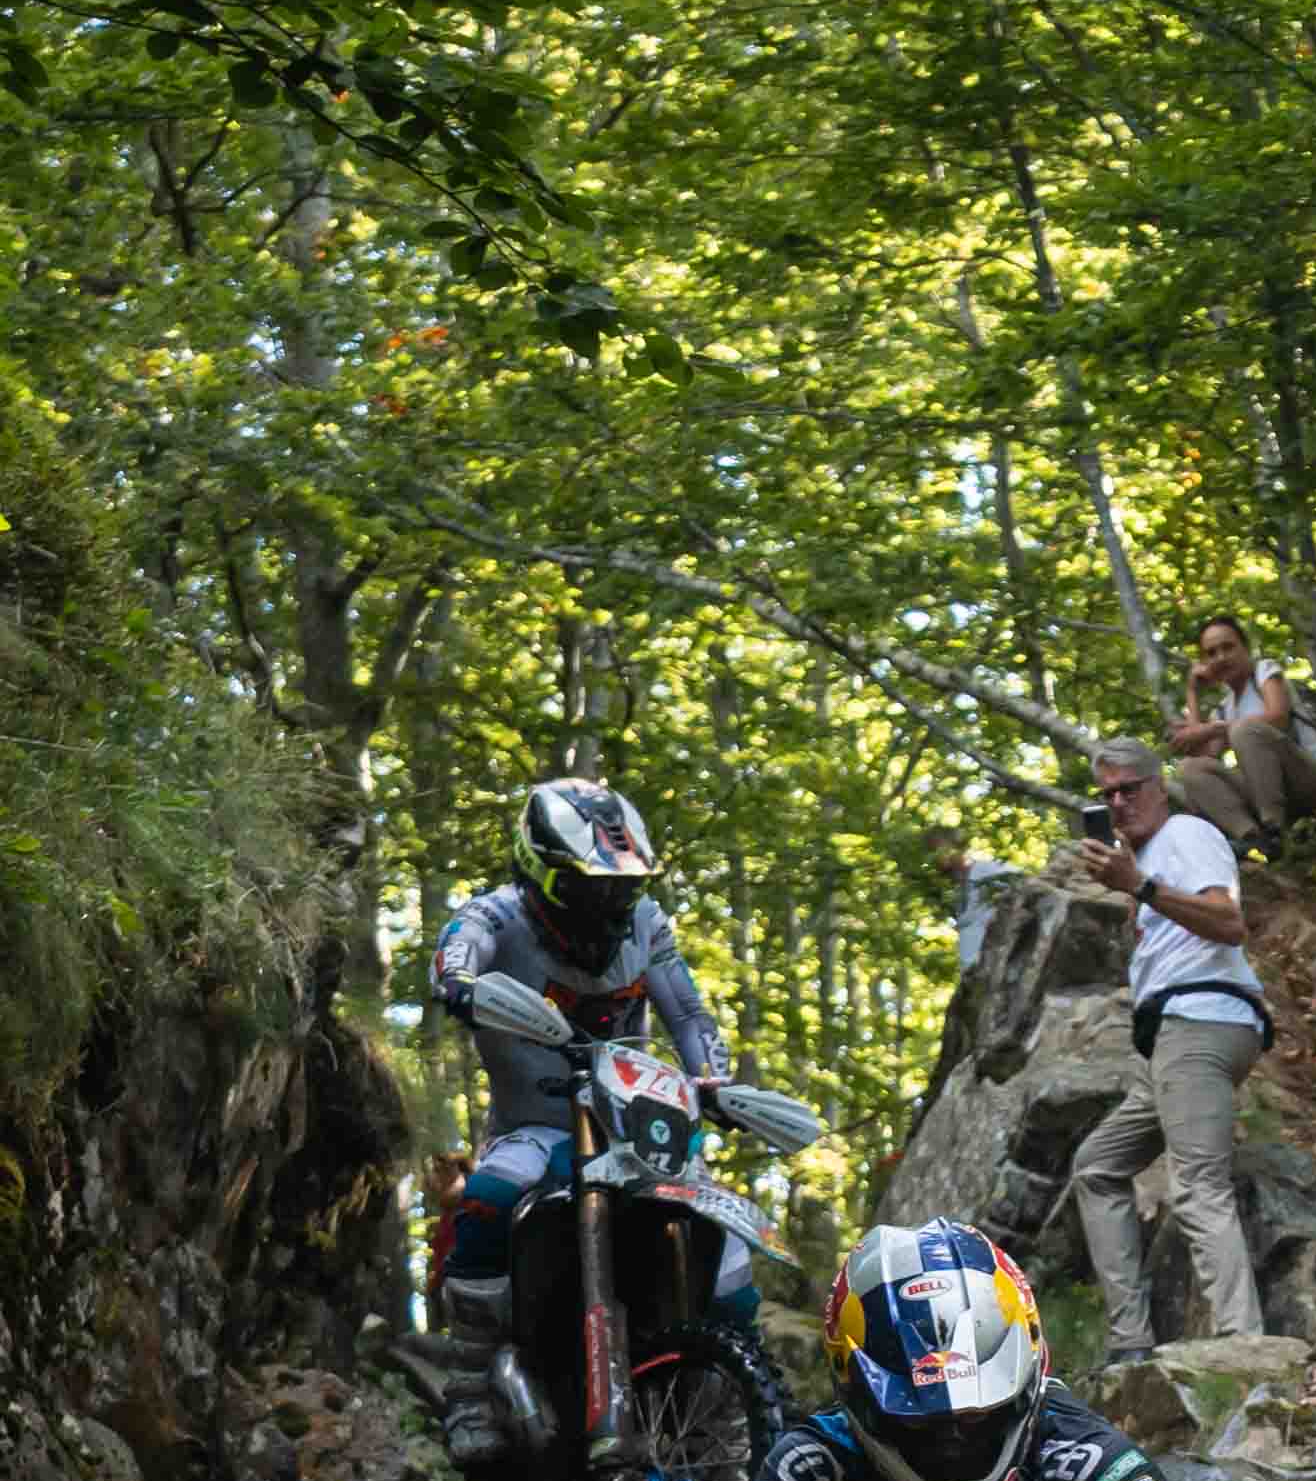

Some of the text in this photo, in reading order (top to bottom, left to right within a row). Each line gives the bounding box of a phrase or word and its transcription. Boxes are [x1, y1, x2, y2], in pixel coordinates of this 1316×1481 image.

[907, 1279, 944, 1296] BELL
[913, 1365, 977, 1387] Red Bull
